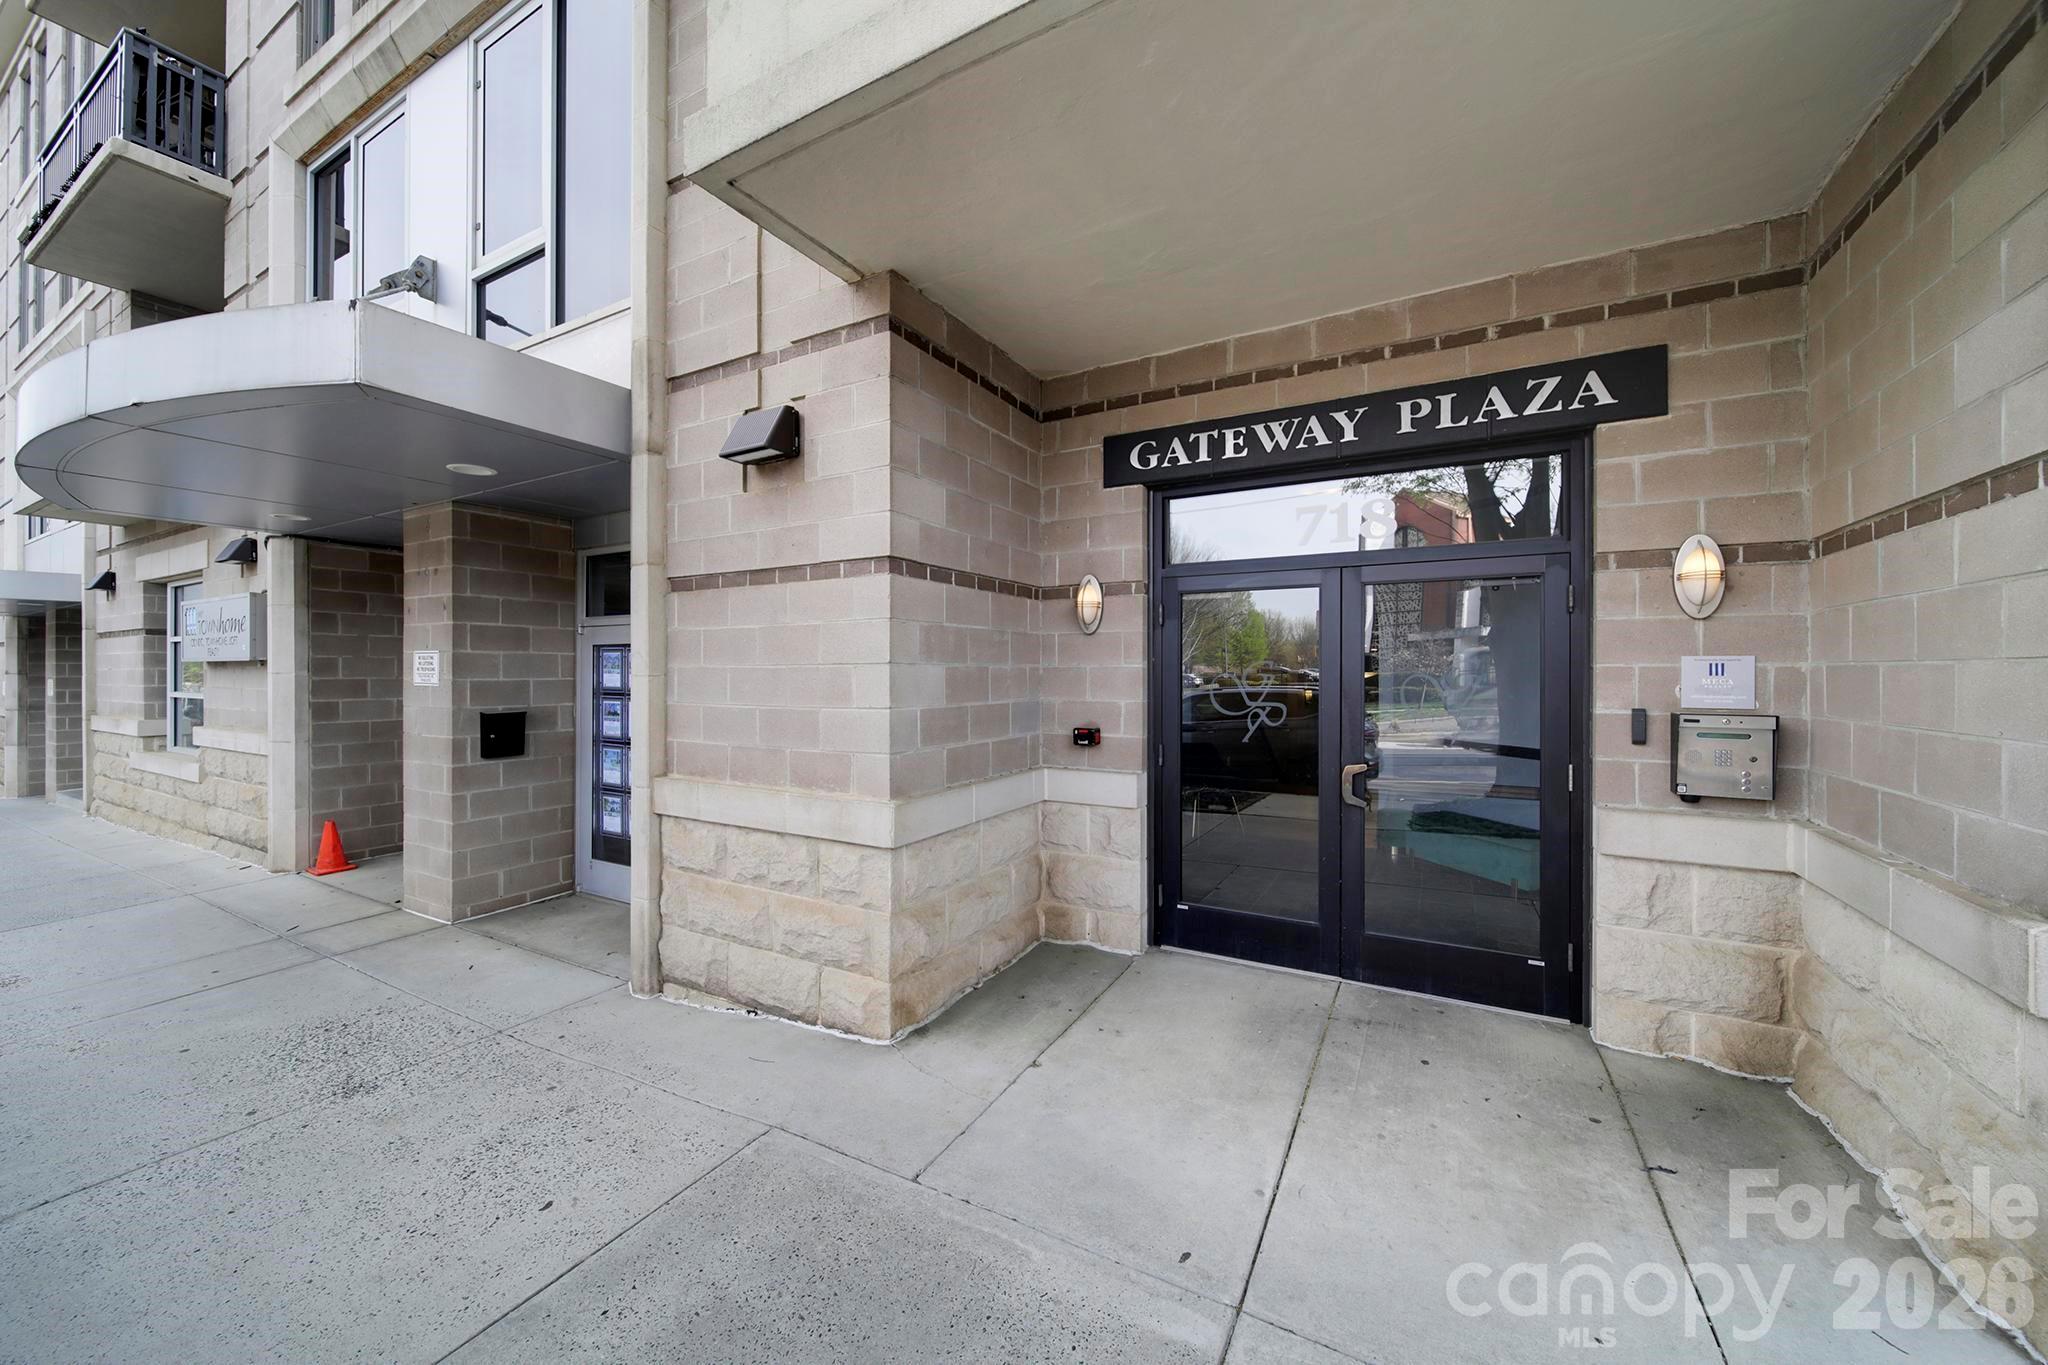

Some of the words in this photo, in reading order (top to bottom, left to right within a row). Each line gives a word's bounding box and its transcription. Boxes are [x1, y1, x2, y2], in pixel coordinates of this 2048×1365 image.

[1129, 407, 1368, 470] GATEWAY
[1396, 369, 1619, 435] PLAZA
[1295, 498, 1397, 547] 718
